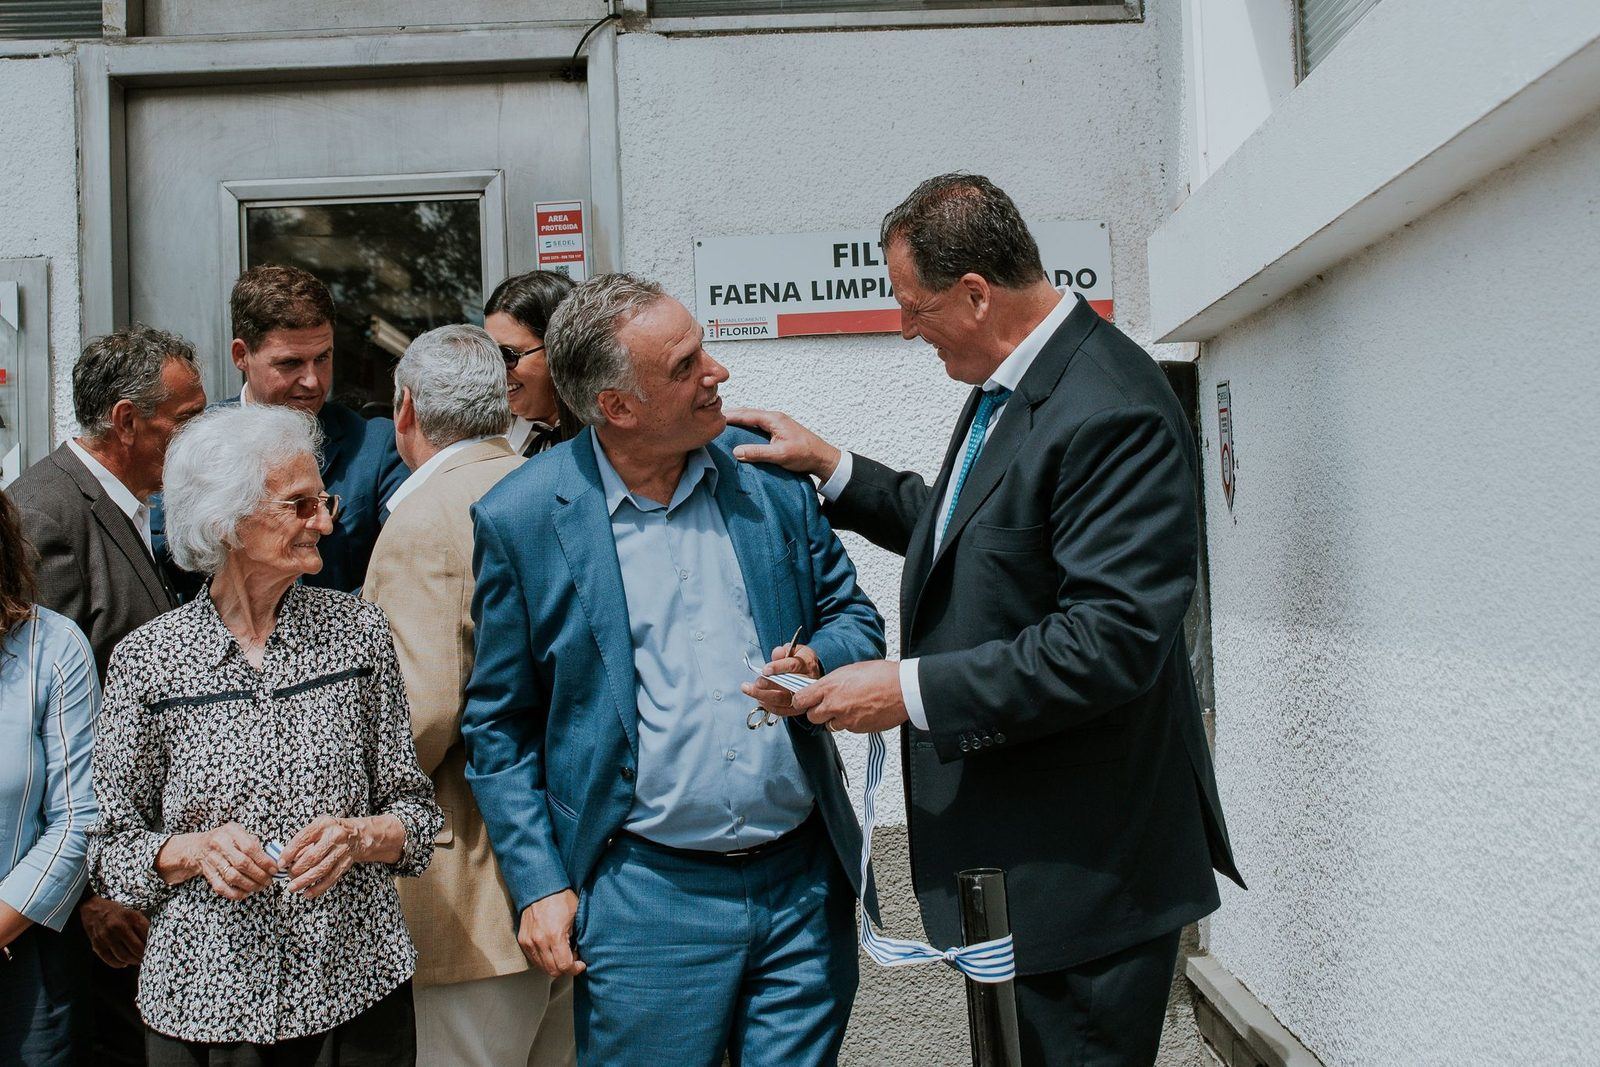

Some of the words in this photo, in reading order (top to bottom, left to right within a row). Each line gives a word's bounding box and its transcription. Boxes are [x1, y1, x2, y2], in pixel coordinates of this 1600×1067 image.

[548, 214, 569, 223] AREA
[541, 223, 578, 232] PROTEGIDA
[710, 281, 802, 306] FAENA
[720, 326, 768, 336] FLORIDA
